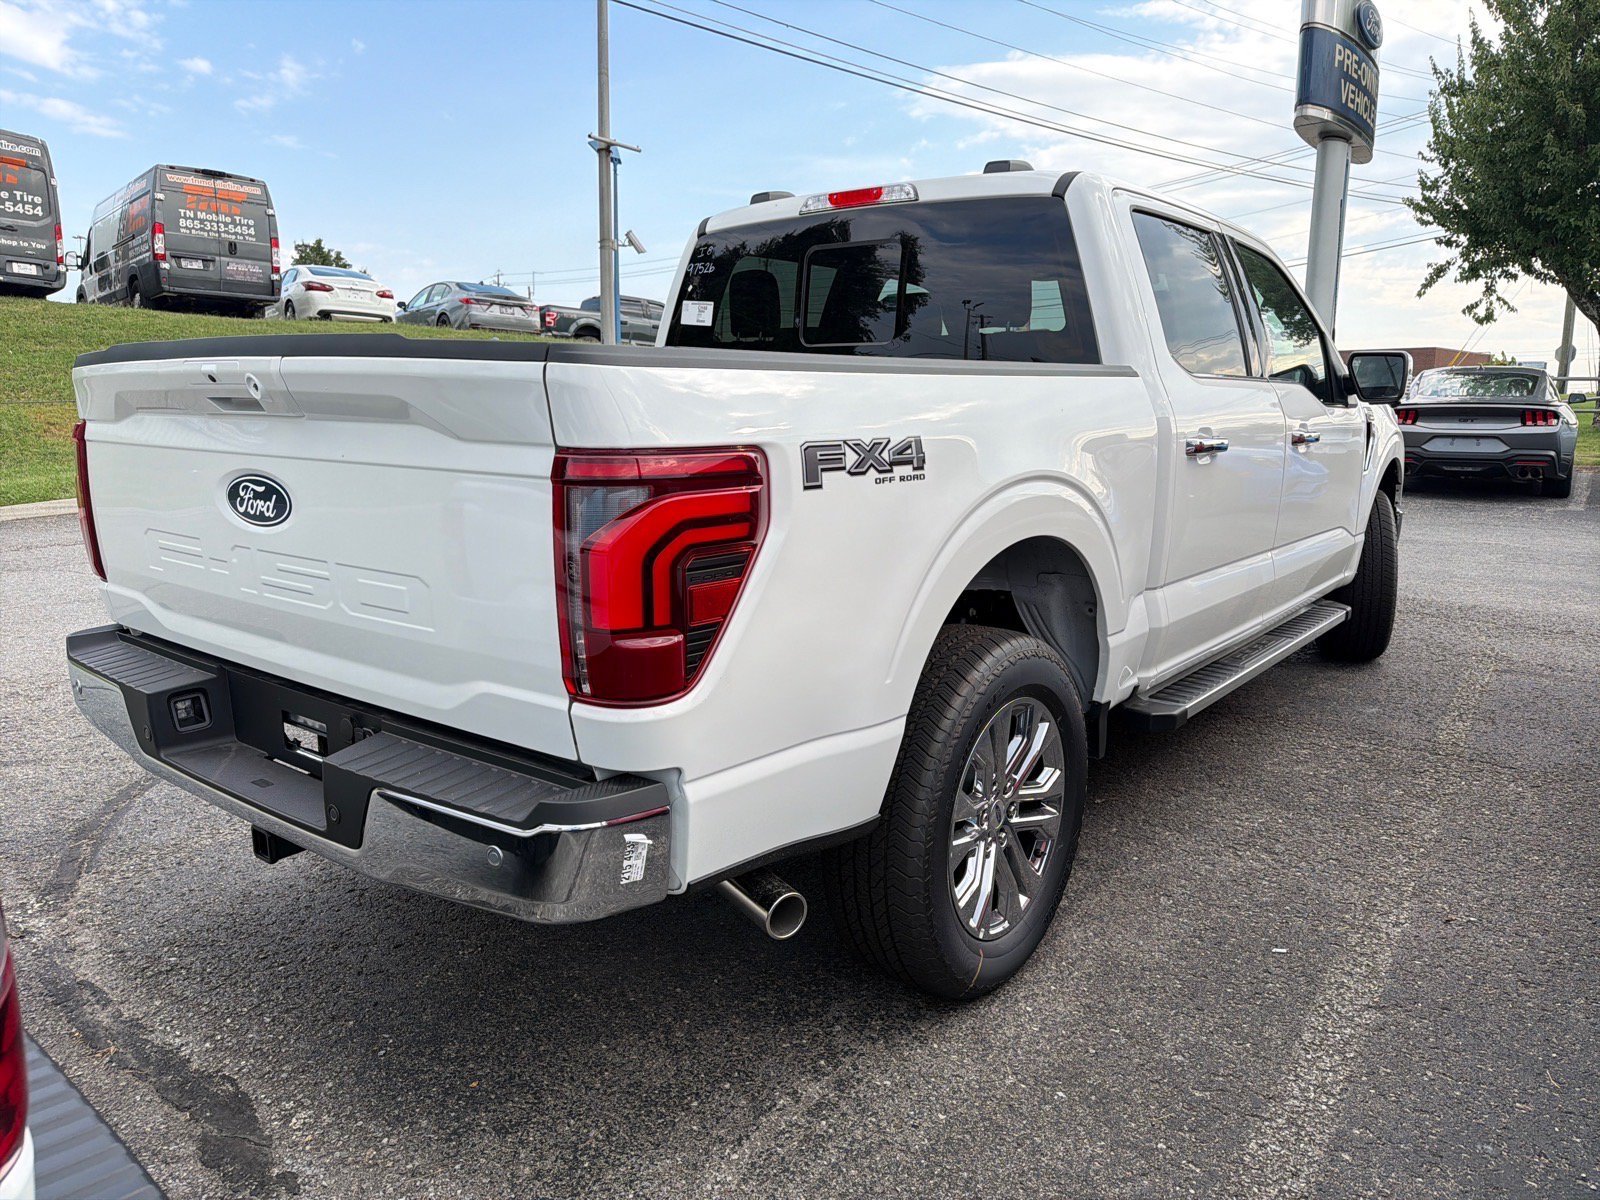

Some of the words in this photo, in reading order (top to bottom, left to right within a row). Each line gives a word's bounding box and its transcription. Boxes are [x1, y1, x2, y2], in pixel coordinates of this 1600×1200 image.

[1334, 43, 1378, 101] PRE-OWN
[1341, 78, 1377, 128] VEHICLE
[13, 190, 43, 204] Tire
[178, 208, 194, 218] TN
[197, 211, 232, 223] Mobile
[233, 215, 255, 226] Tire
[178, 218, 255, 236] 865-333-5454
[0, 237, 18, 247] hop
[30, 241, 46, 250] You
[800, 436, 926, 491] FX4
[874, 476, 896, 485] OFF
[899, 473, 926, 483] ROAD
[236, 481, 277, 518] Ford
